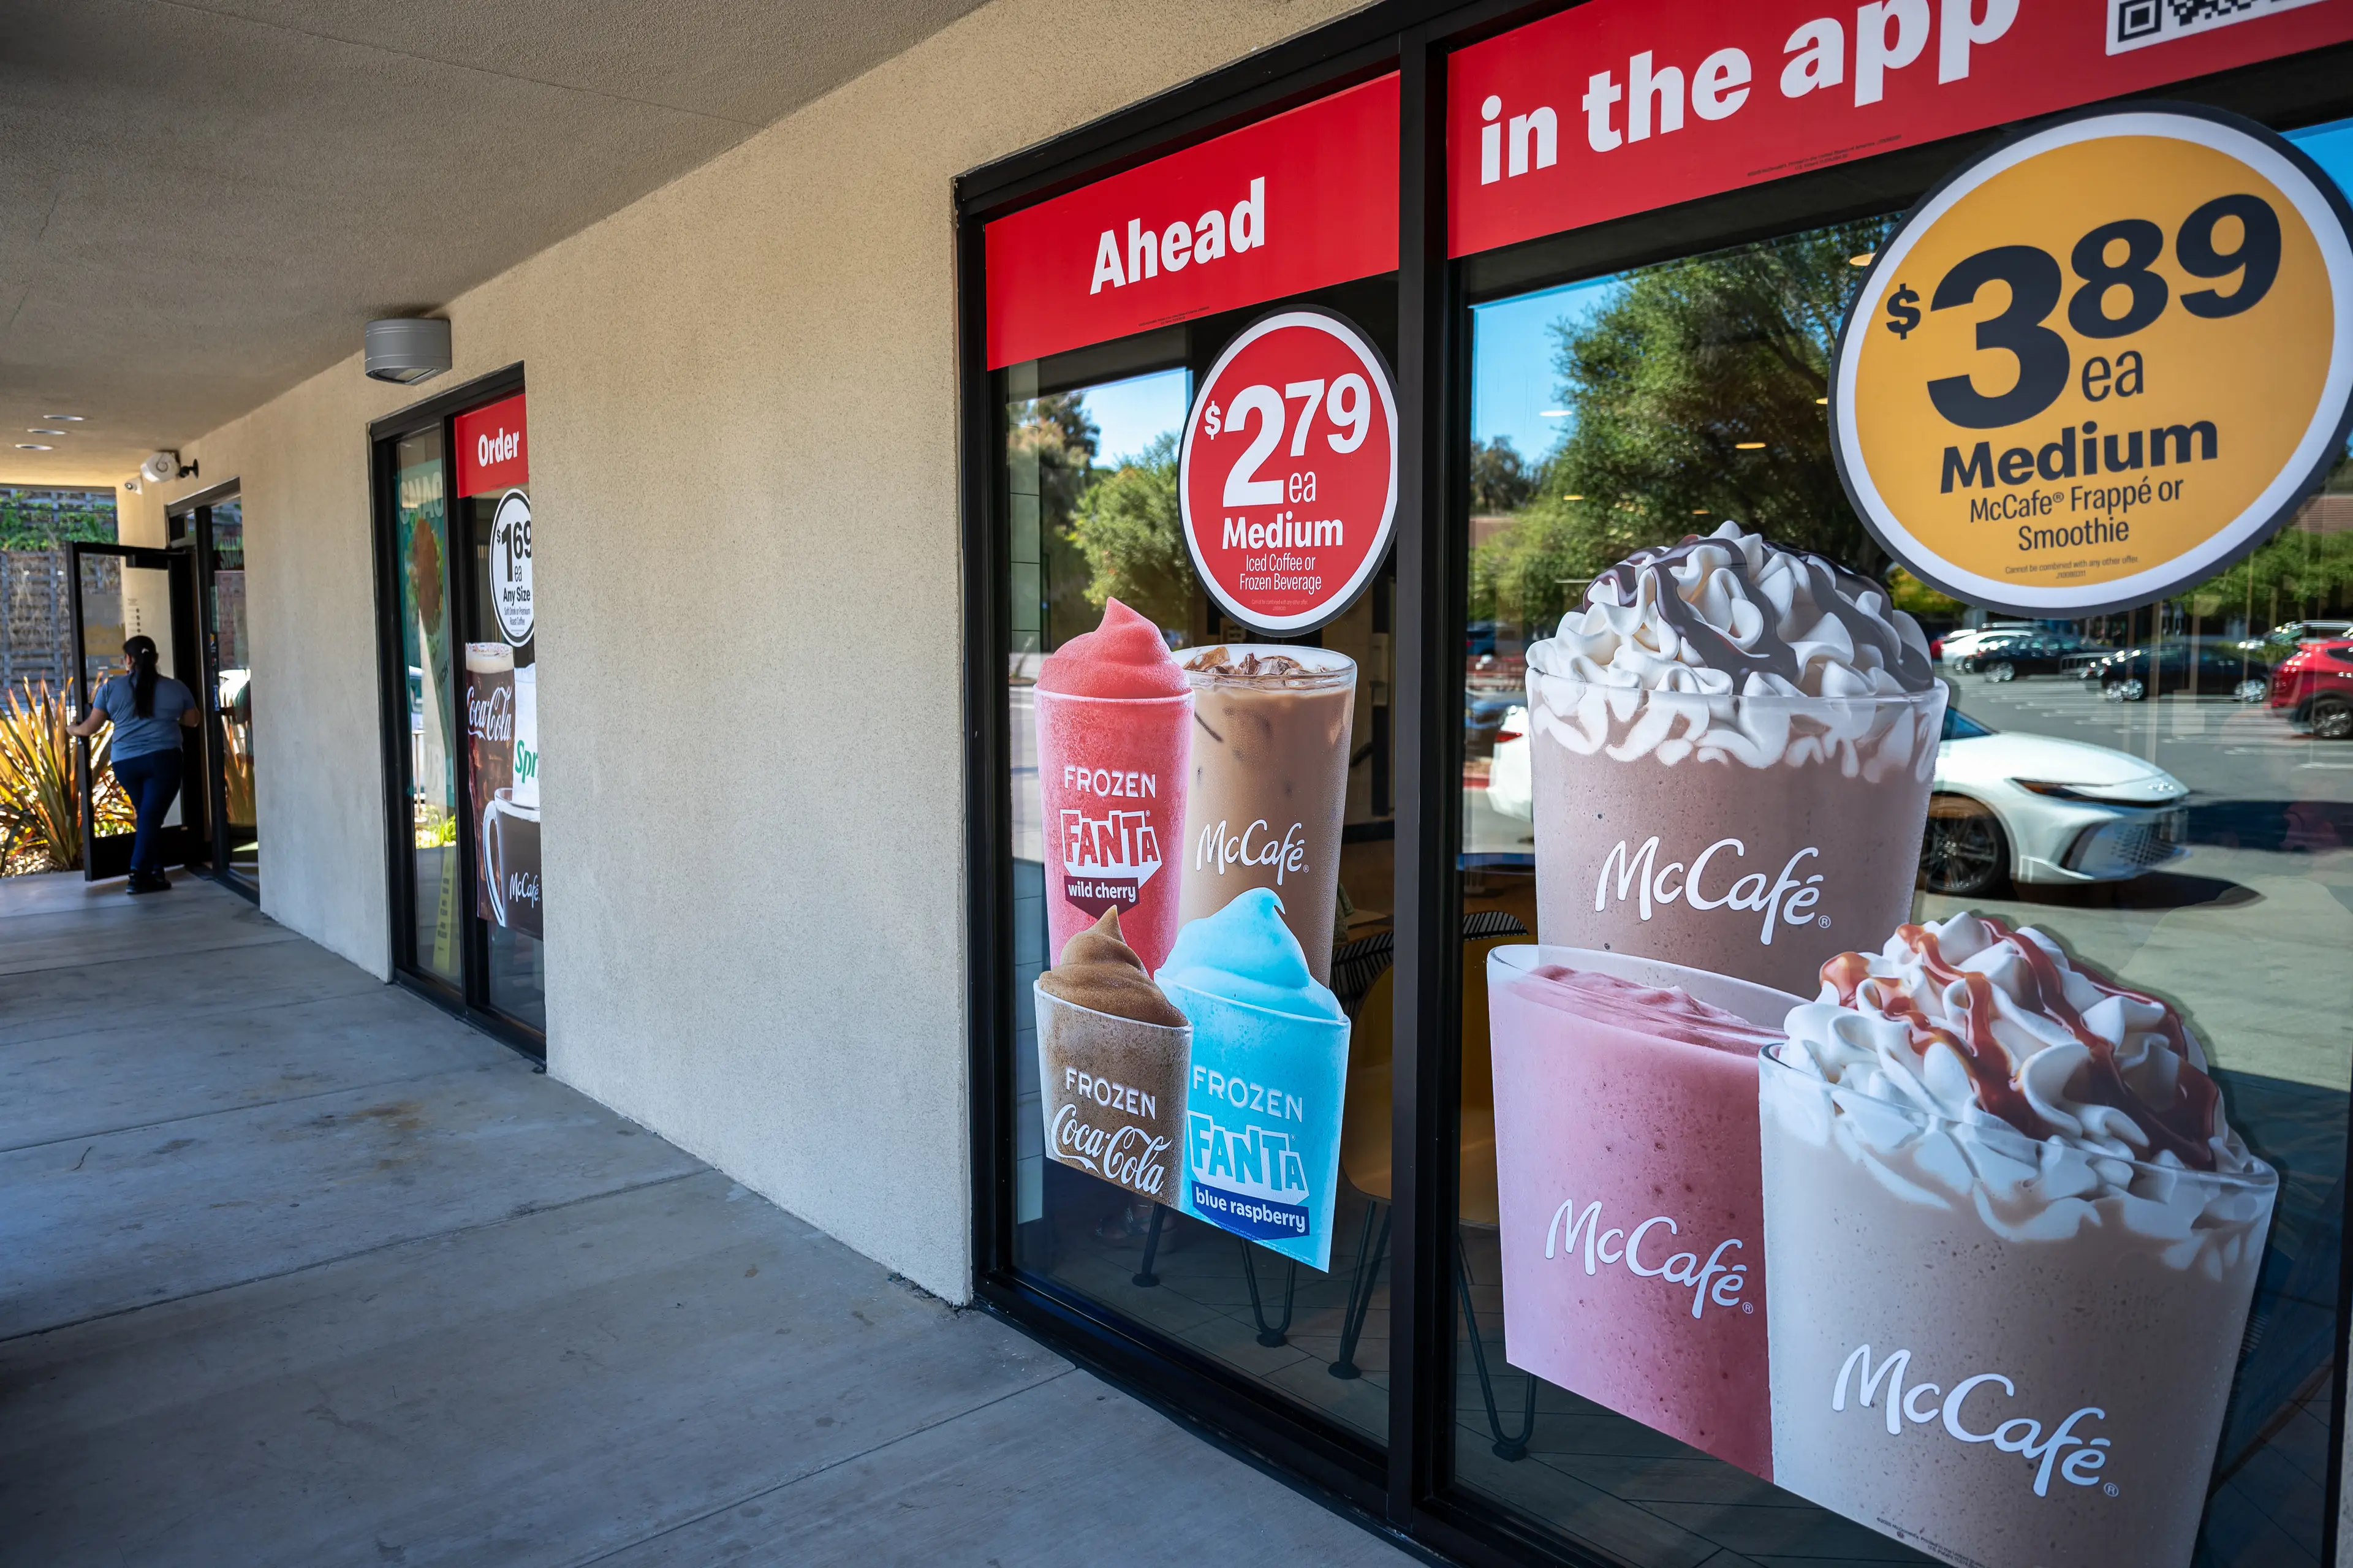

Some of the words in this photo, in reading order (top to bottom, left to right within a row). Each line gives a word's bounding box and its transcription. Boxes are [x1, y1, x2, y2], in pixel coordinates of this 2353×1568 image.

[1480, 95, 1558, 186] in
[1582, 49, 1752, 153] the
[1779, 0, 2021, 108] app
[1089, 176, 1265, 295] Ahead
[2081, 350, 2144, 403] ea
[479, 427, 520, 467] Order
[1940, 420, 2218, 494] Medium
[1289, 471, 1316, 503] ea
[2071, 476, 2152, 515] Frappé
[2158, 479, 2184, 502] or
[1222, 510, 1343, 550] Medium
[2018, 517, 2129, 551] Smoothie
[515, 565, 522, 582] ea
[1246, 553, 1267, 571] Iced
[1269, 552, 1302, 571] Coffee
[1305, 556, 1316, 570] or
[2005, 565, 2028, 574] Cannot
[2039, 561, 2071, 572] combined
[2073, 560, 2087, 569] with
[2089, 558, 2101, 568] any
[2102, 556, 2120, 566] other
[503, 587, 515, 606] Any
[517, 586, 531, 602] Size
[1240, 574, 1271, 590] Frozen
[1274, 573, 1321, 595] Beverage
[515, 740, 539, 784] Spr
[1064, 764, 1156, 798] FROZEN
[1068, 881, 1093, 898] wild
[1095, 882, 1137, 903] cherry
[1065, 1066, 1156, 1120] FROZEN
[1192, 1064, 1303, 1123] FROZEN
[1195, 1186, 1227, 1212] blue
[1230, 1201, 1305, 1233] raspberry
